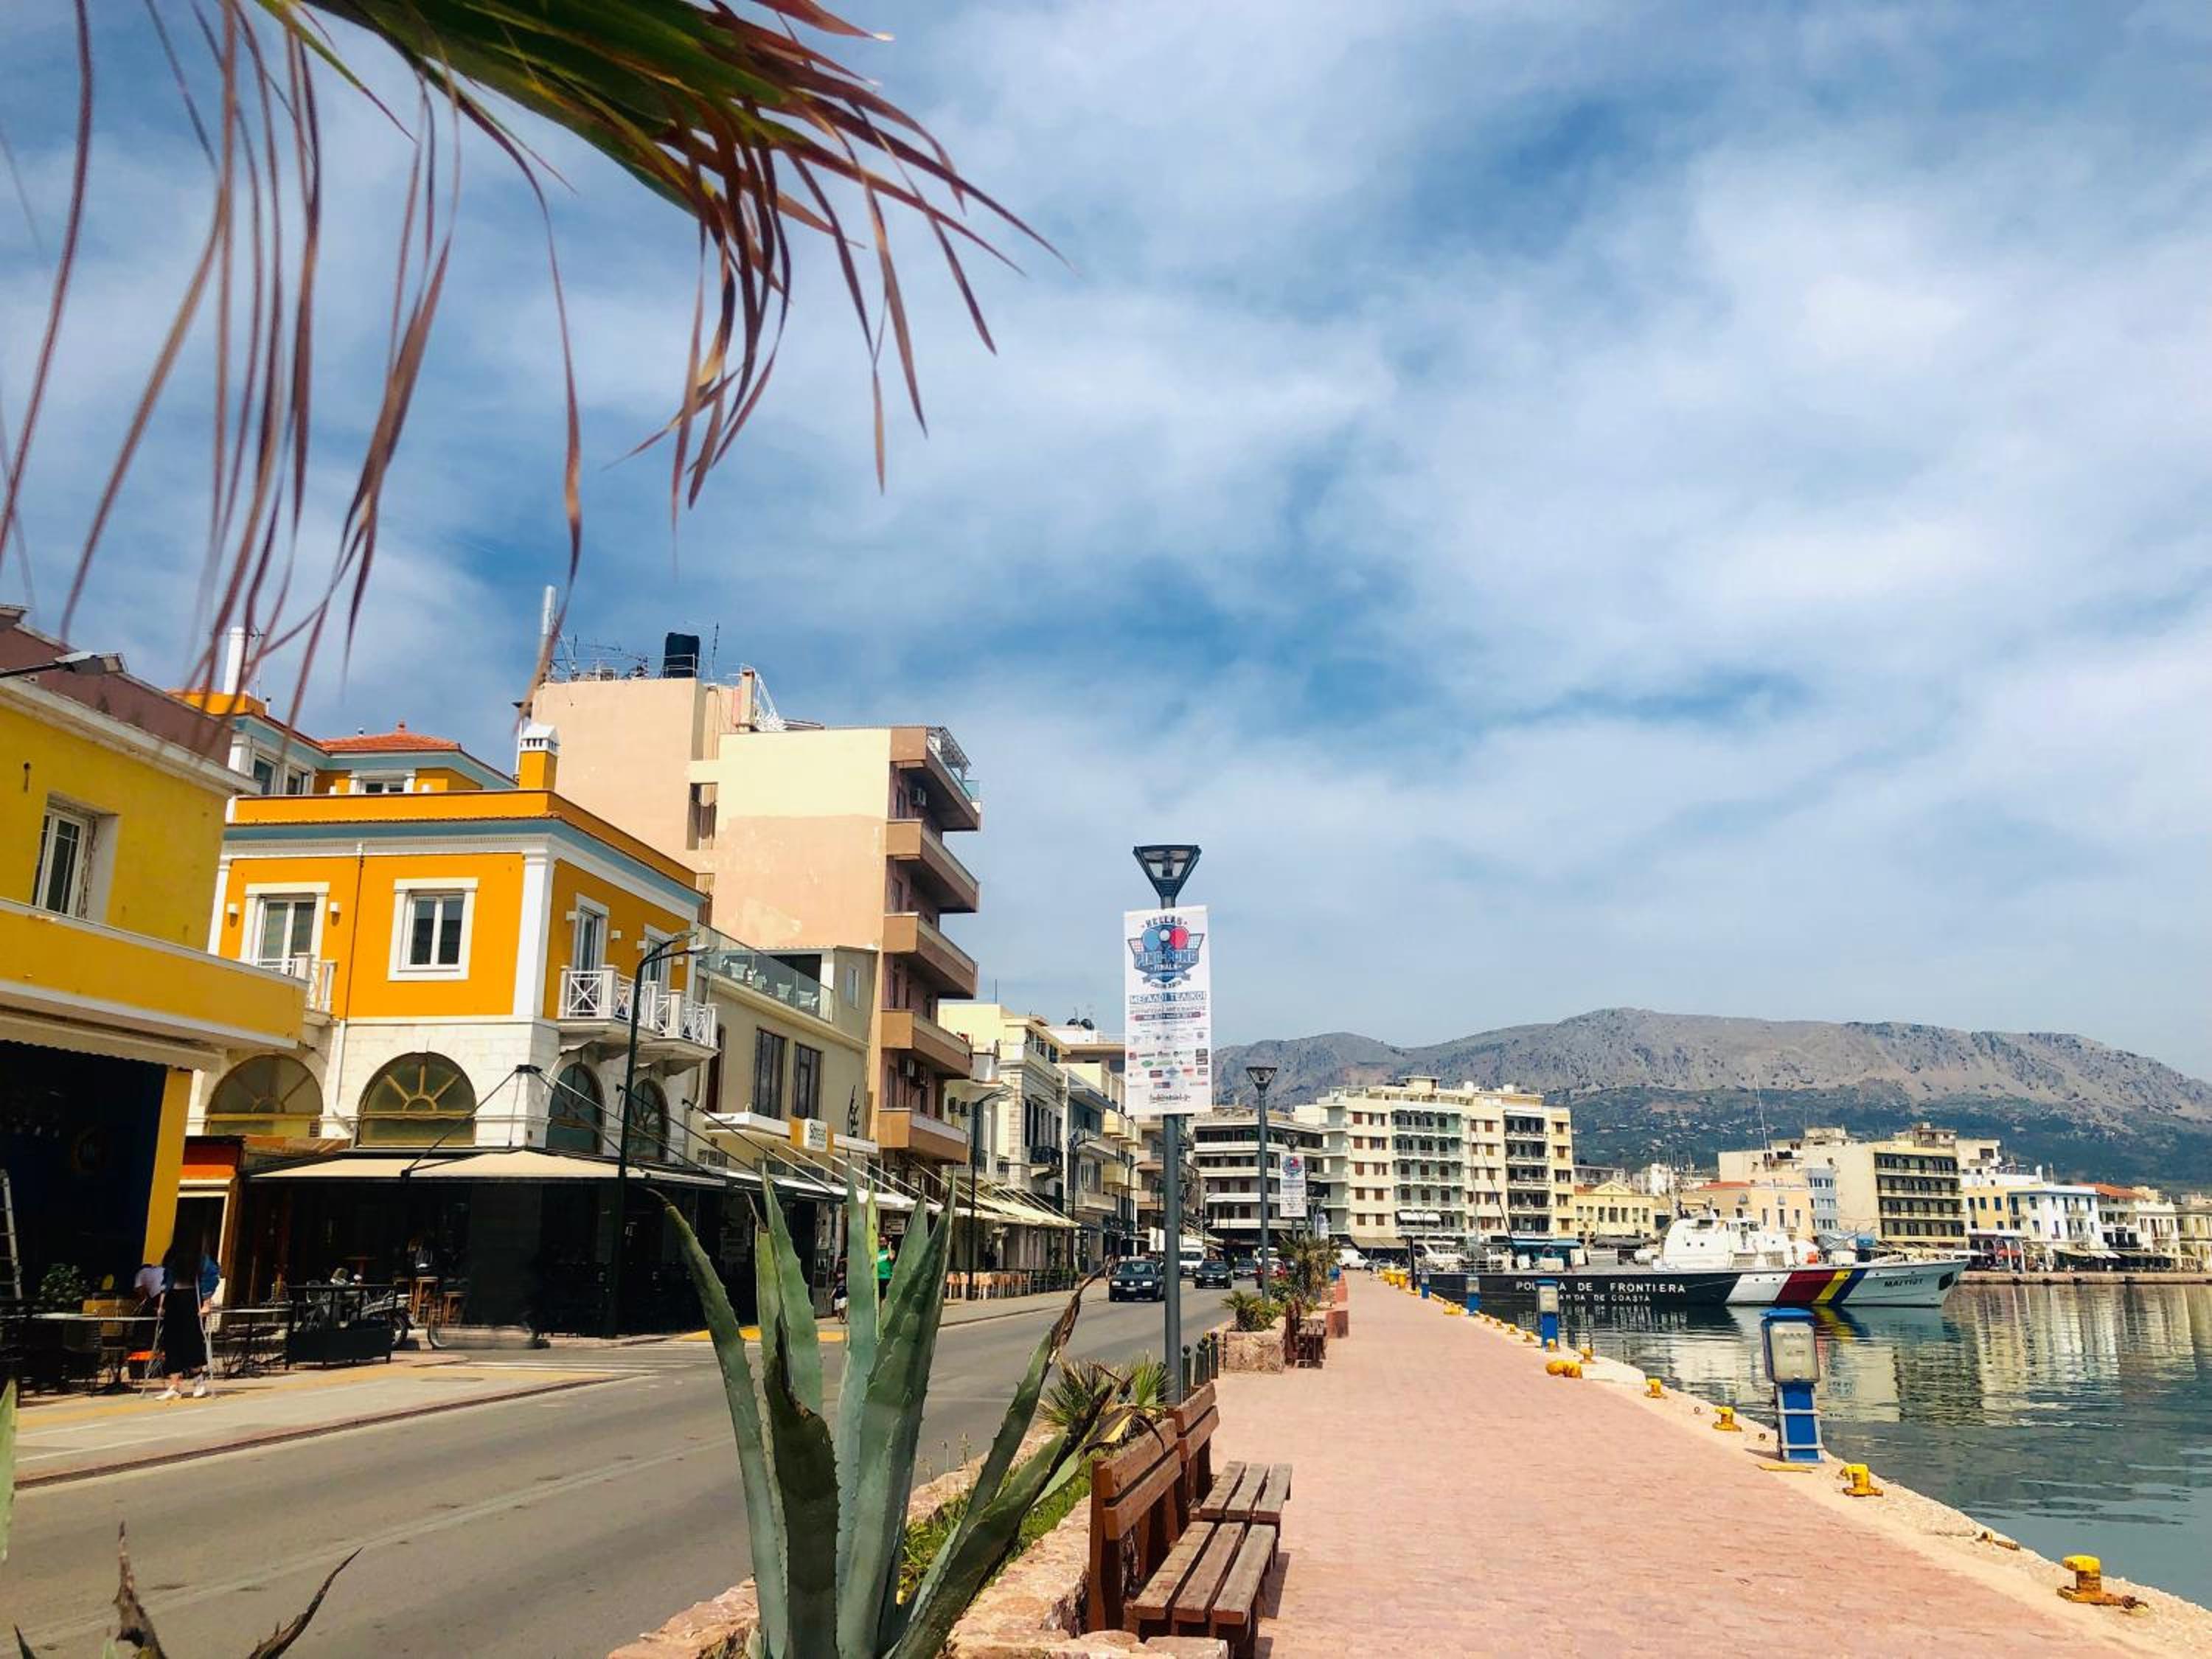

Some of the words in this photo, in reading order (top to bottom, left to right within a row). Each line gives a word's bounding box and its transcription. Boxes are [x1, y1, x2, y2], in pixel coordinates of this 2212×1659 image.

[1515, 1281, 1567, 1291] POLA
[1577, 1282, 1593, 1292] DE
[1610, 1282, 1686, 1293] FRONTIERA
